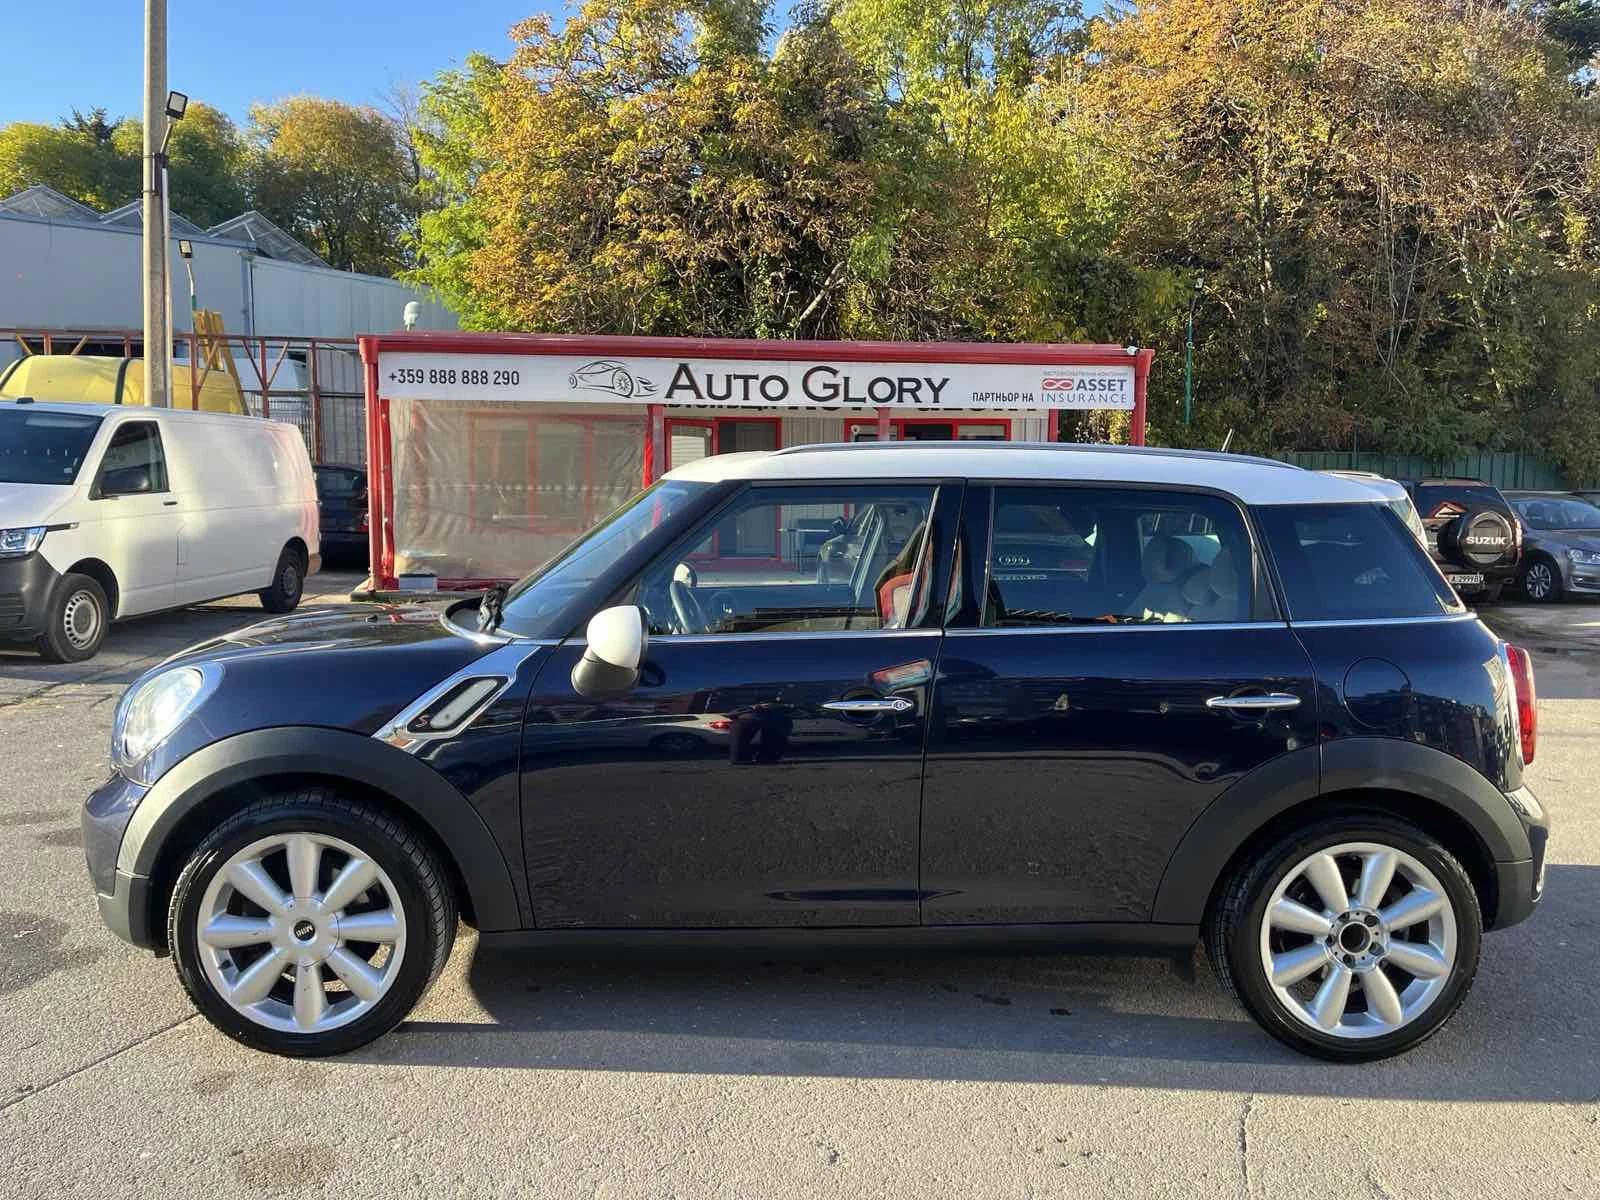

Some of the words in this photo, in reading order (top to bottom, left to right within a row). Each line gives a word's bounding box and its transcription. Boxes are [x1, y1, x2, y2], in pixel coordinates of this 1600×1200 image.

[388, 368, 424, 384] +359
[429, 369, 456, 385] 888
[461, 370, 489, 386] 888
[493, 370, 520, 386] 290
[1076, 378, 1127, 392] ASSET
[972, 391, 1020, 403] ПАРТНЬОР
[1022, 392, 1034, 403] НА
[1041, 392, 1127, 404] INSURANCE
[415, 714, 430, 728] S
